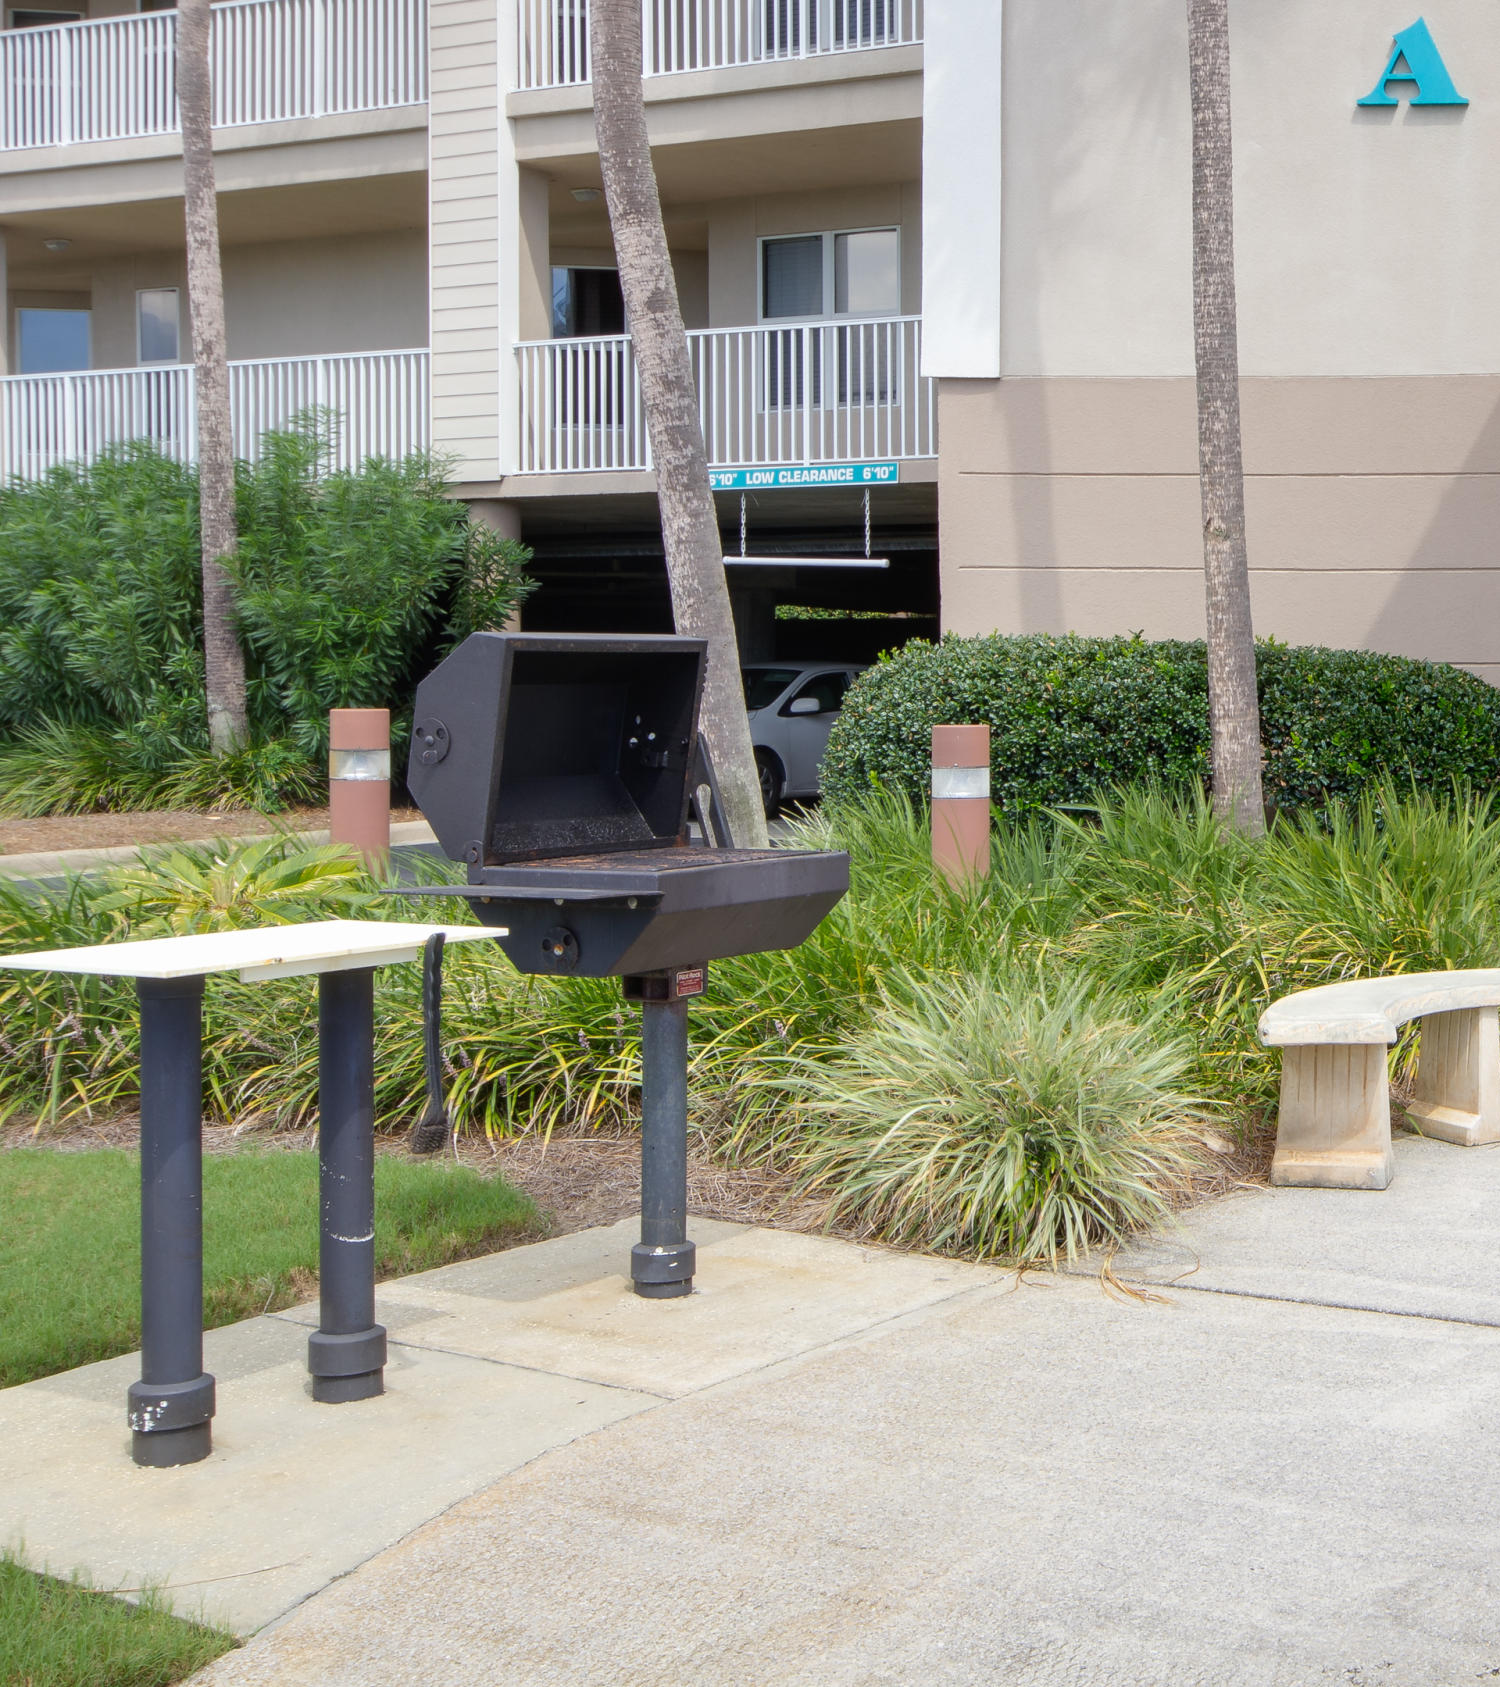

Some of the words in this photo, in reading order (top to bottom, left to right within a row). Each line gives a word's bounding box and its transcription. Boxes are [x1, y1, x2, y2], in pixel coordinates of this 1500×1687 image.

[1357, 15, 1469, 107] A
[746, 472, 774, 484] LOW
[779, 468, 854, 483] CLEARANCE
[863, 466, 894, 479] 6'10"
